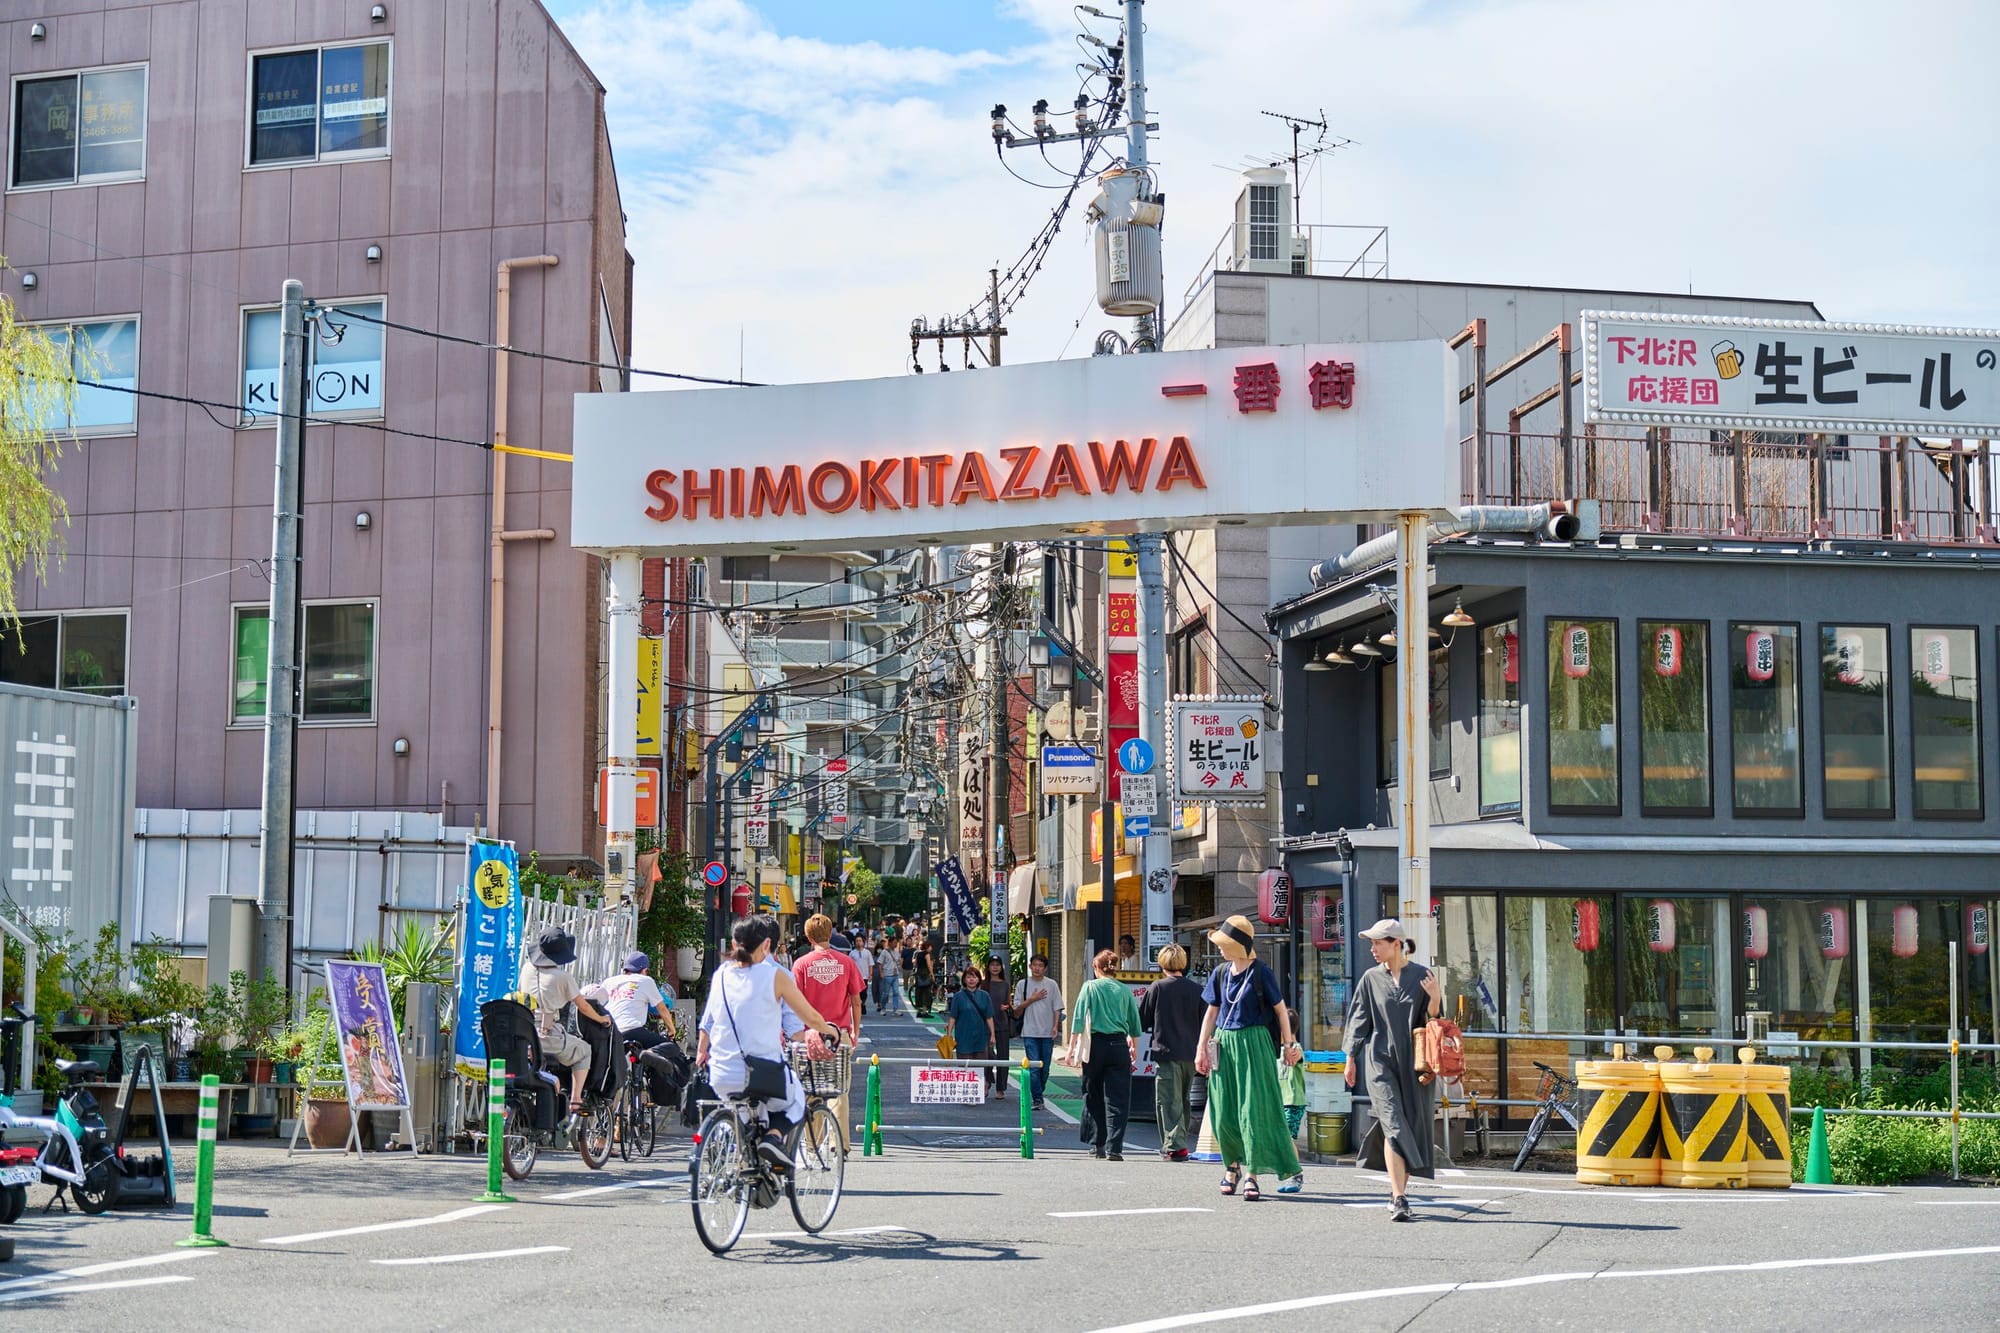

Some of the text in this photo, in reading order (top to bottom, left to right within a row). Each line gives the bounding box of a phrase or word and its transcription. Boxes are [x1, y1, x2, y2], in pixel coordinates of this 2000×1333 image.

[1607, 335, 1697, 367] 下北沢
[248, 371, 369, 404] KUON
[1161, 359, 1355, 413] 一番街
[1627, 375, 1720, 406] 応援団
[1754, 340, 1967, 411] 生ビール
[644, 435, 1207, 522] SHIMOKITAZAWA
[1190, 714, 1219, 725] 下北沢
[1204, 726, 1235, 736] 応援団
[1048, 753, 1091, 762] Panasonic
[1188, 739, 1259, 762] 生ビール
[1196, 761, 1250, 771] のうまい店
[1271, 877, 1289, 919] 居酒屋
[917, 1070, 979, 1083] 車両通行止
